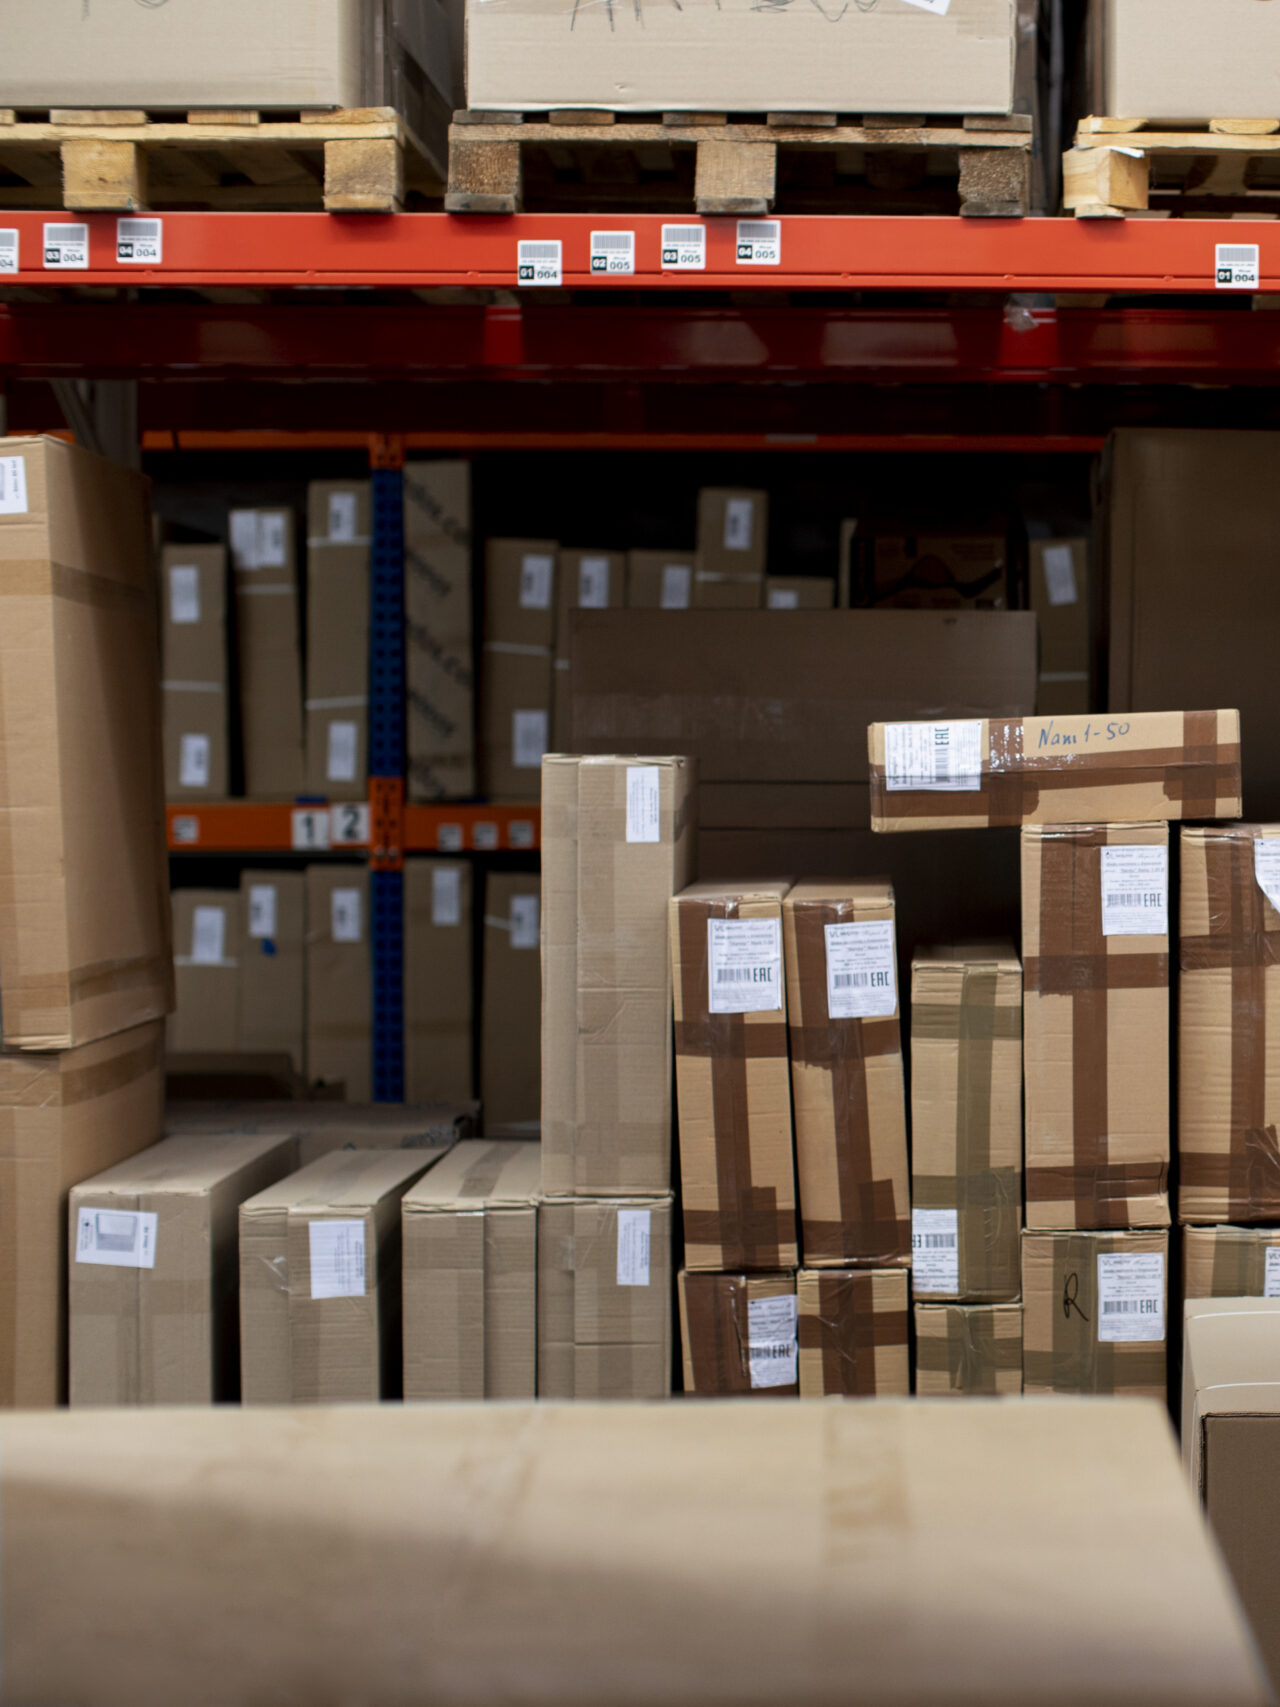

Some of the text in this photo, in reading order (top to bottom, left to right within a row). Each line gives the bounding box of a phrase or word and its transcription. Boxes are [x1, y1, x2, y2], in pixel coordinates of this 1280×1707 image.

[63, 254, 84, 262] 004
[136, 249, 156, 257] 004
[681, 254, 701, 263] 005
[738, 247, 775, 259] 04 005
[610, 261, 630, 270] 005
[520, 268, 557, 279] 01 004
[1218, 271, 1255, 282] 01 004
[934, 727, 949, 746] EAC
[303, 808, 360, 839] 1 2
[1144, 893, 1162, 908] EAC
[753, 967, 772, 983] EAC
[870, 971, 890, 987] EAC
[1140, 1299, 1158, 1314] EAC
[772, 1343, 791, 1359] EAC
